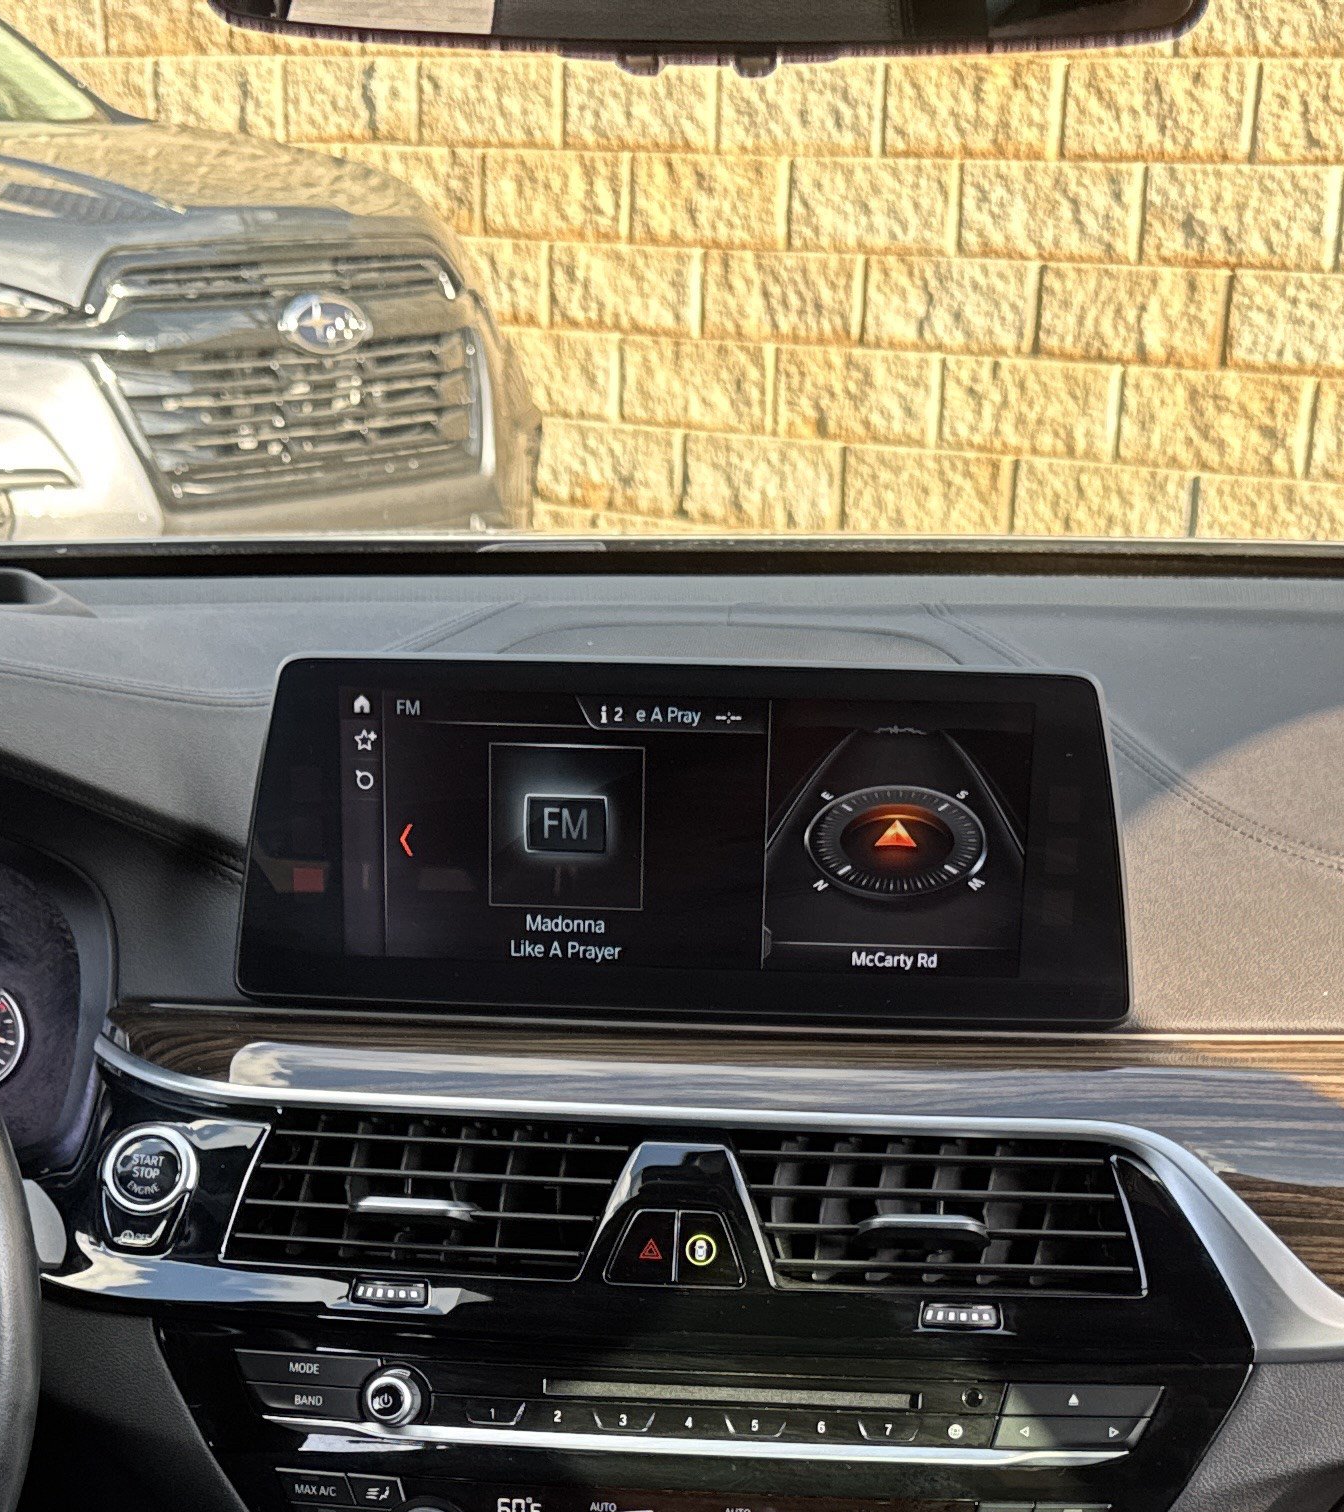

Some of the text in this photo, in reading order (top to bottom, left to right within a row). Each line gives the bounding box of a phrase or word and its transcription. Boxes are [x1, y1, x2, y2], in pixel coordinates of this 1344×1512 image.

[396, 699, 421, 716] FM
[614, 707, 623, 722] 2
[650, 708, 663, 722] A
[667, 708, 701, 726] Pray
[543, 807, 588, 841] FM
[525, 914, 606, 934] Madonna
[510, 940, 622, 963] Like A Prayer
[851, 951, 938, 970] McCarty Rd
[131, 1153, 166, 1167] START
[131, 1165, 160, 1179] STOP
[126, 1180, 161, 1195] ENGINE
[289, 1362, 320, 1376] MODE
[294, 1393, 323, 1407] BAND
[553, 1410, 562, 1424] 2
[619, 1413, 628, 1427] 3
[684, 1416, 693, 1429] 4
[750, 1418, 759, 1432] 5
[817, 1421, 826, 1434] 6
[884, 1423, 893, 1436] 7
[294, 1483, 337, 1498] MAX A/C
[589, 1501, 617, 1512] AUTO
